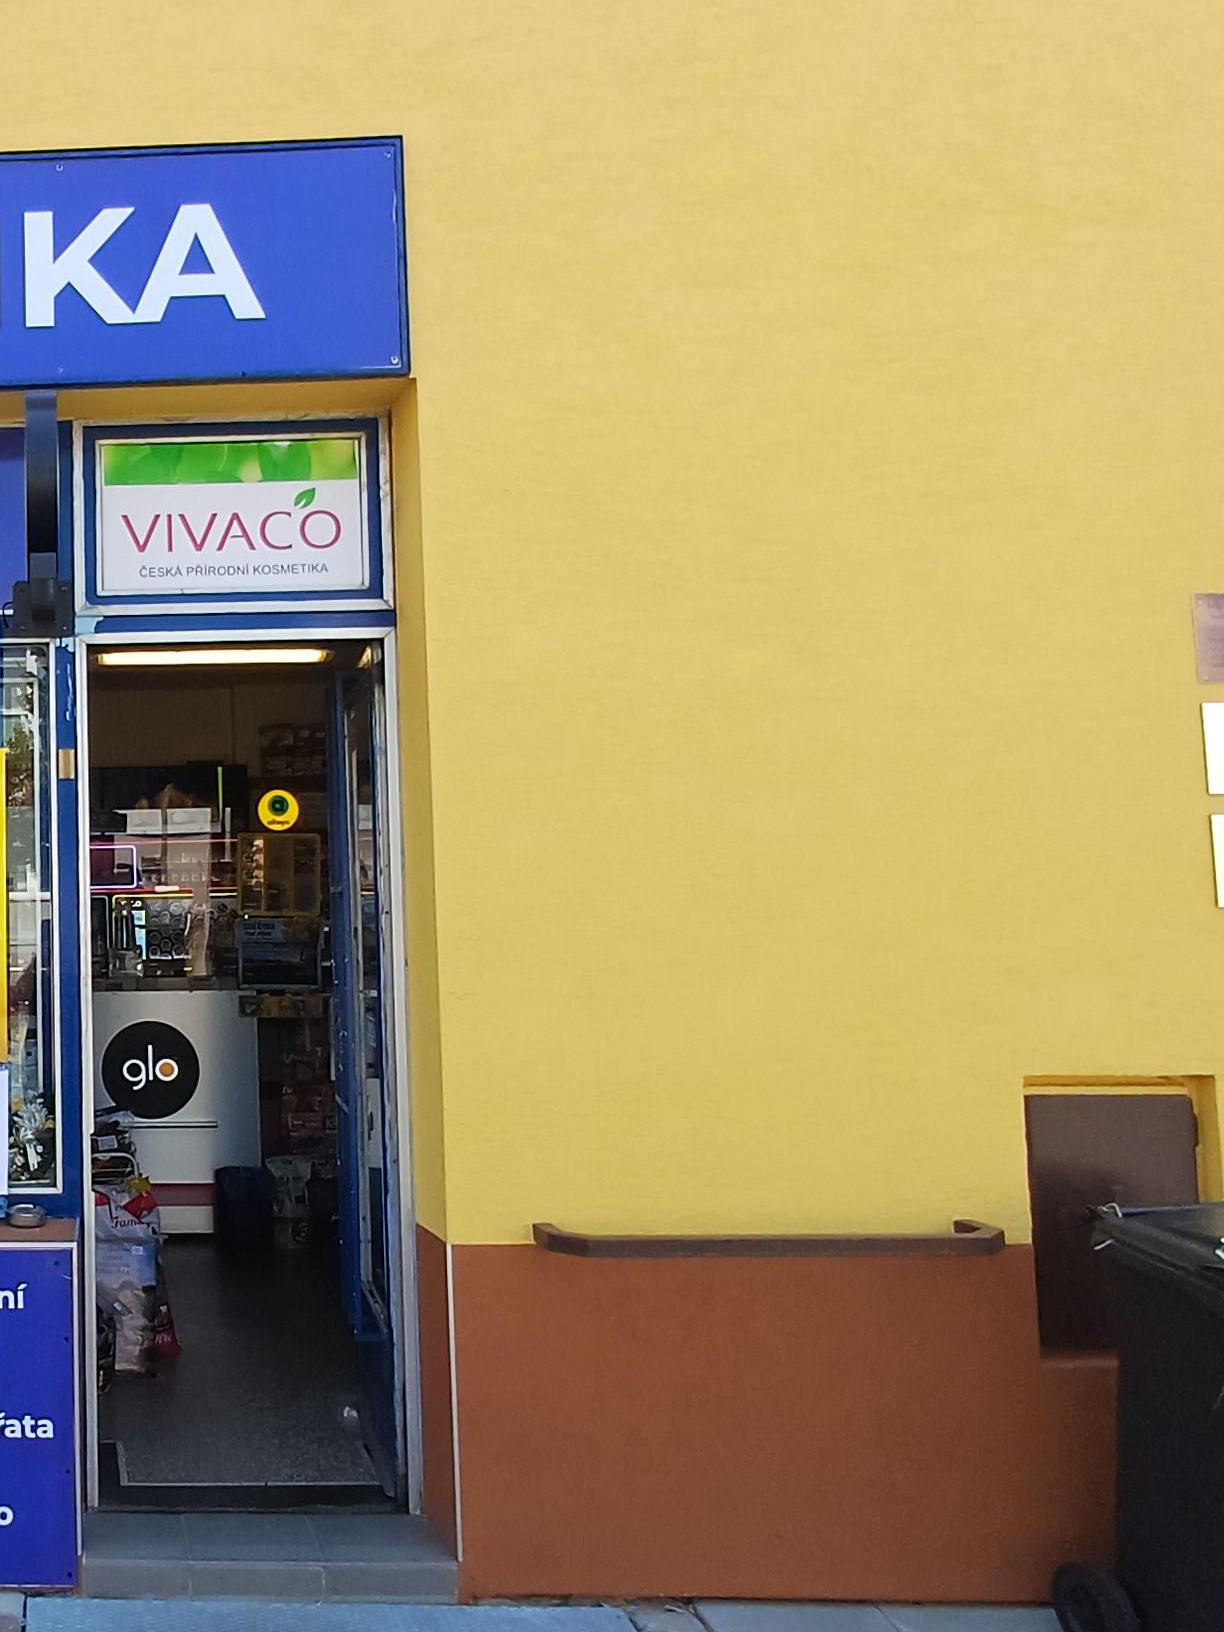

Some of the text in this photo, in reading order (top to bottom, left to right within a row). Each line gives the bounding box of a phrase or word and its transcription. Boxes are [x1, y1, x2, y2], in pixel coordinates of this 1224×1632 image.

[121, 509, 342, 553] VIVACO
[139, 562, 329, 578] ČESKÁ PŘÍRODNÍ KOSMETIKA
[122, 1044, 179, 1091] glo
